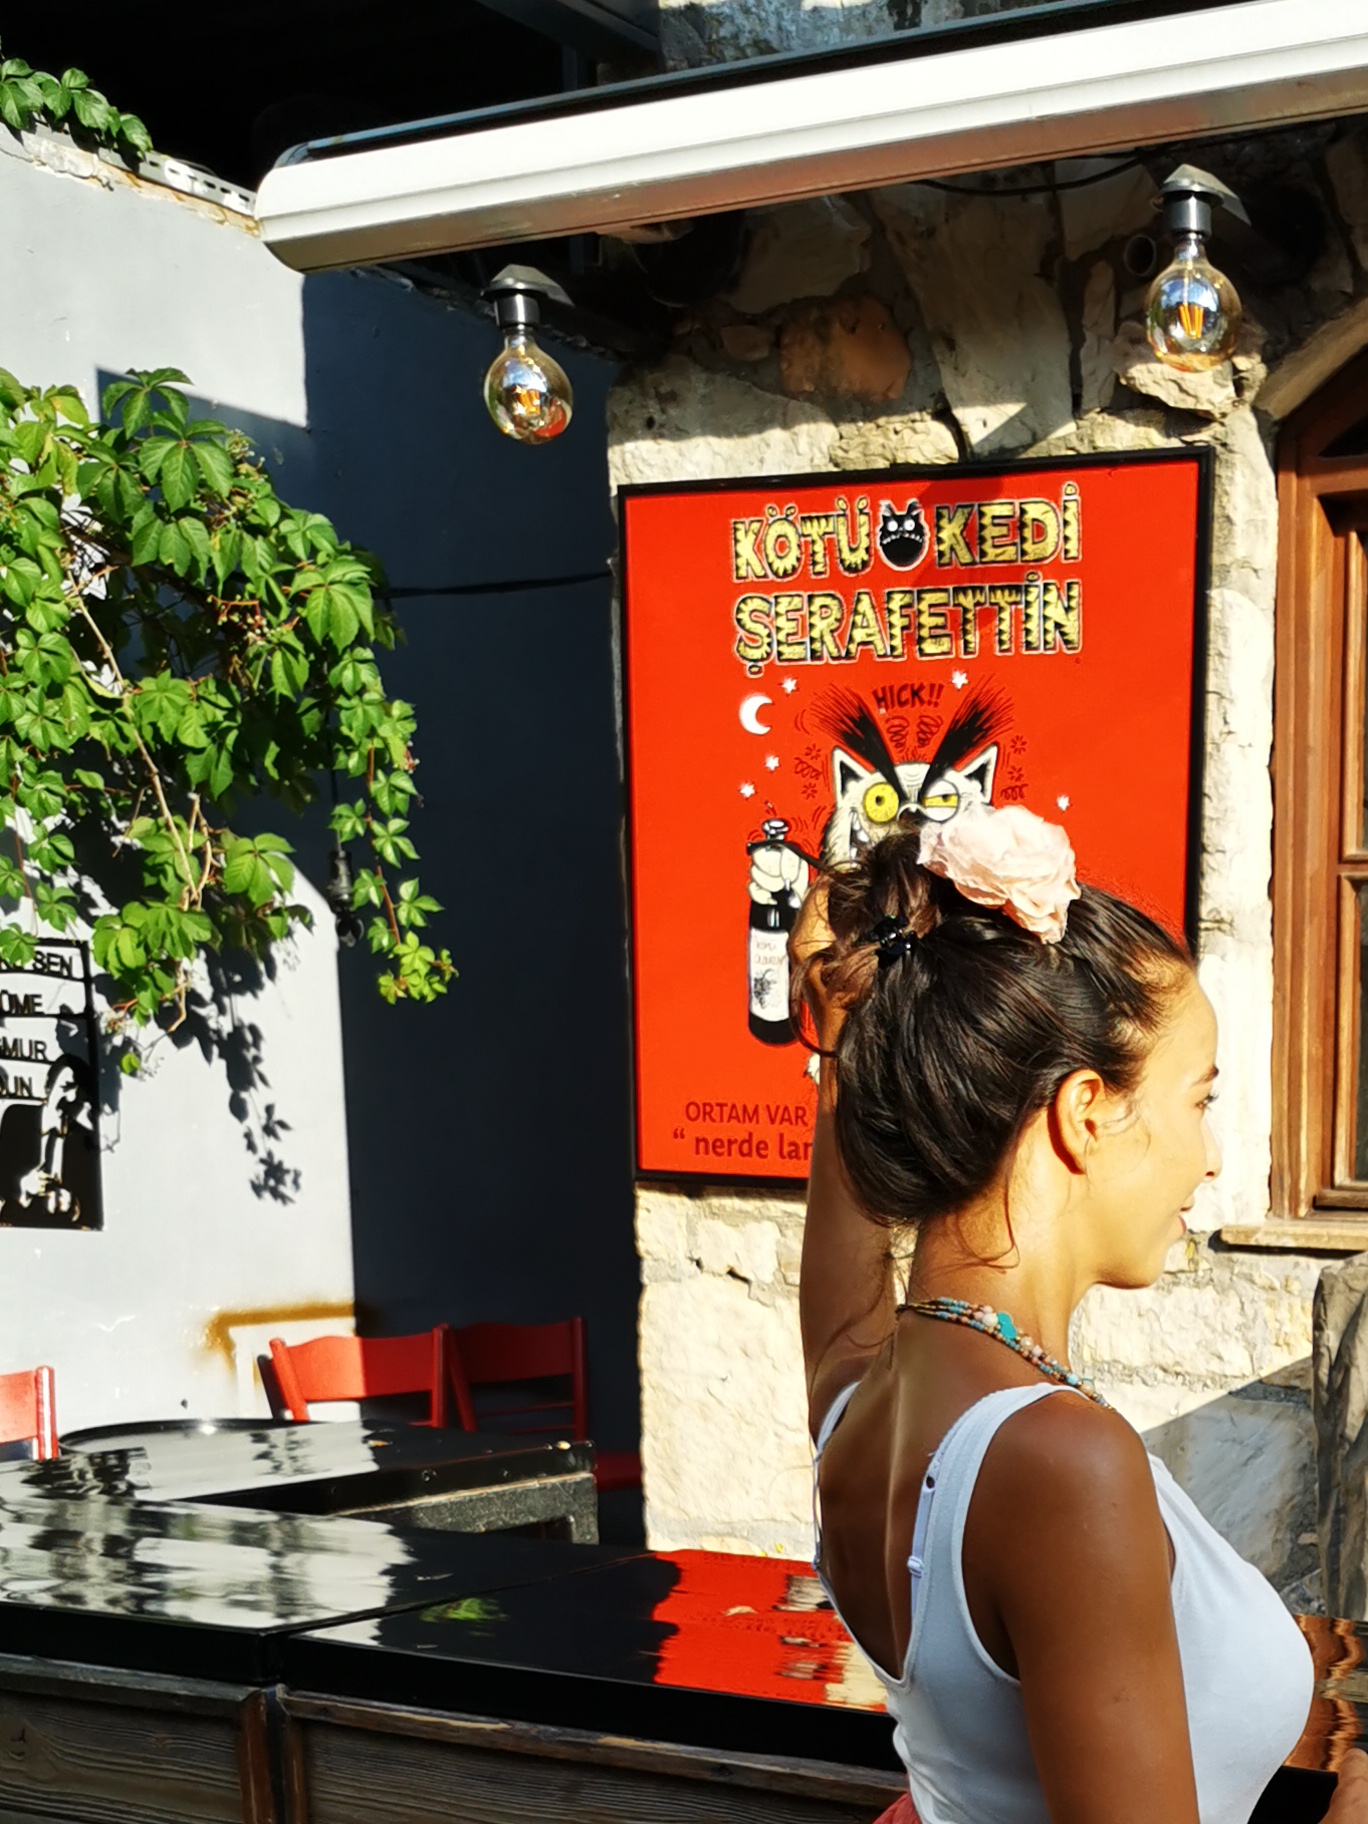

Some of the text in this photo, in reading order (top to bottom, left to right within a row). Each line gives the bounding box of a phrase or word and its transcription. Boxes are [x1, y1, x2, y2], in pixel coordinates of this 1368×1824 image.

[733, 482, 1083, 583] KÖTÜ KEDİ
[735, 570, 1083, 678] ŞERAFETTİN
[872, 682, 945, 711] HICK!!
[0, 1035, 49, 1062] MUR
[685, 1101, 808, 1127] ORTAM VAR
[695, 1131, 769, 1159] nerde
